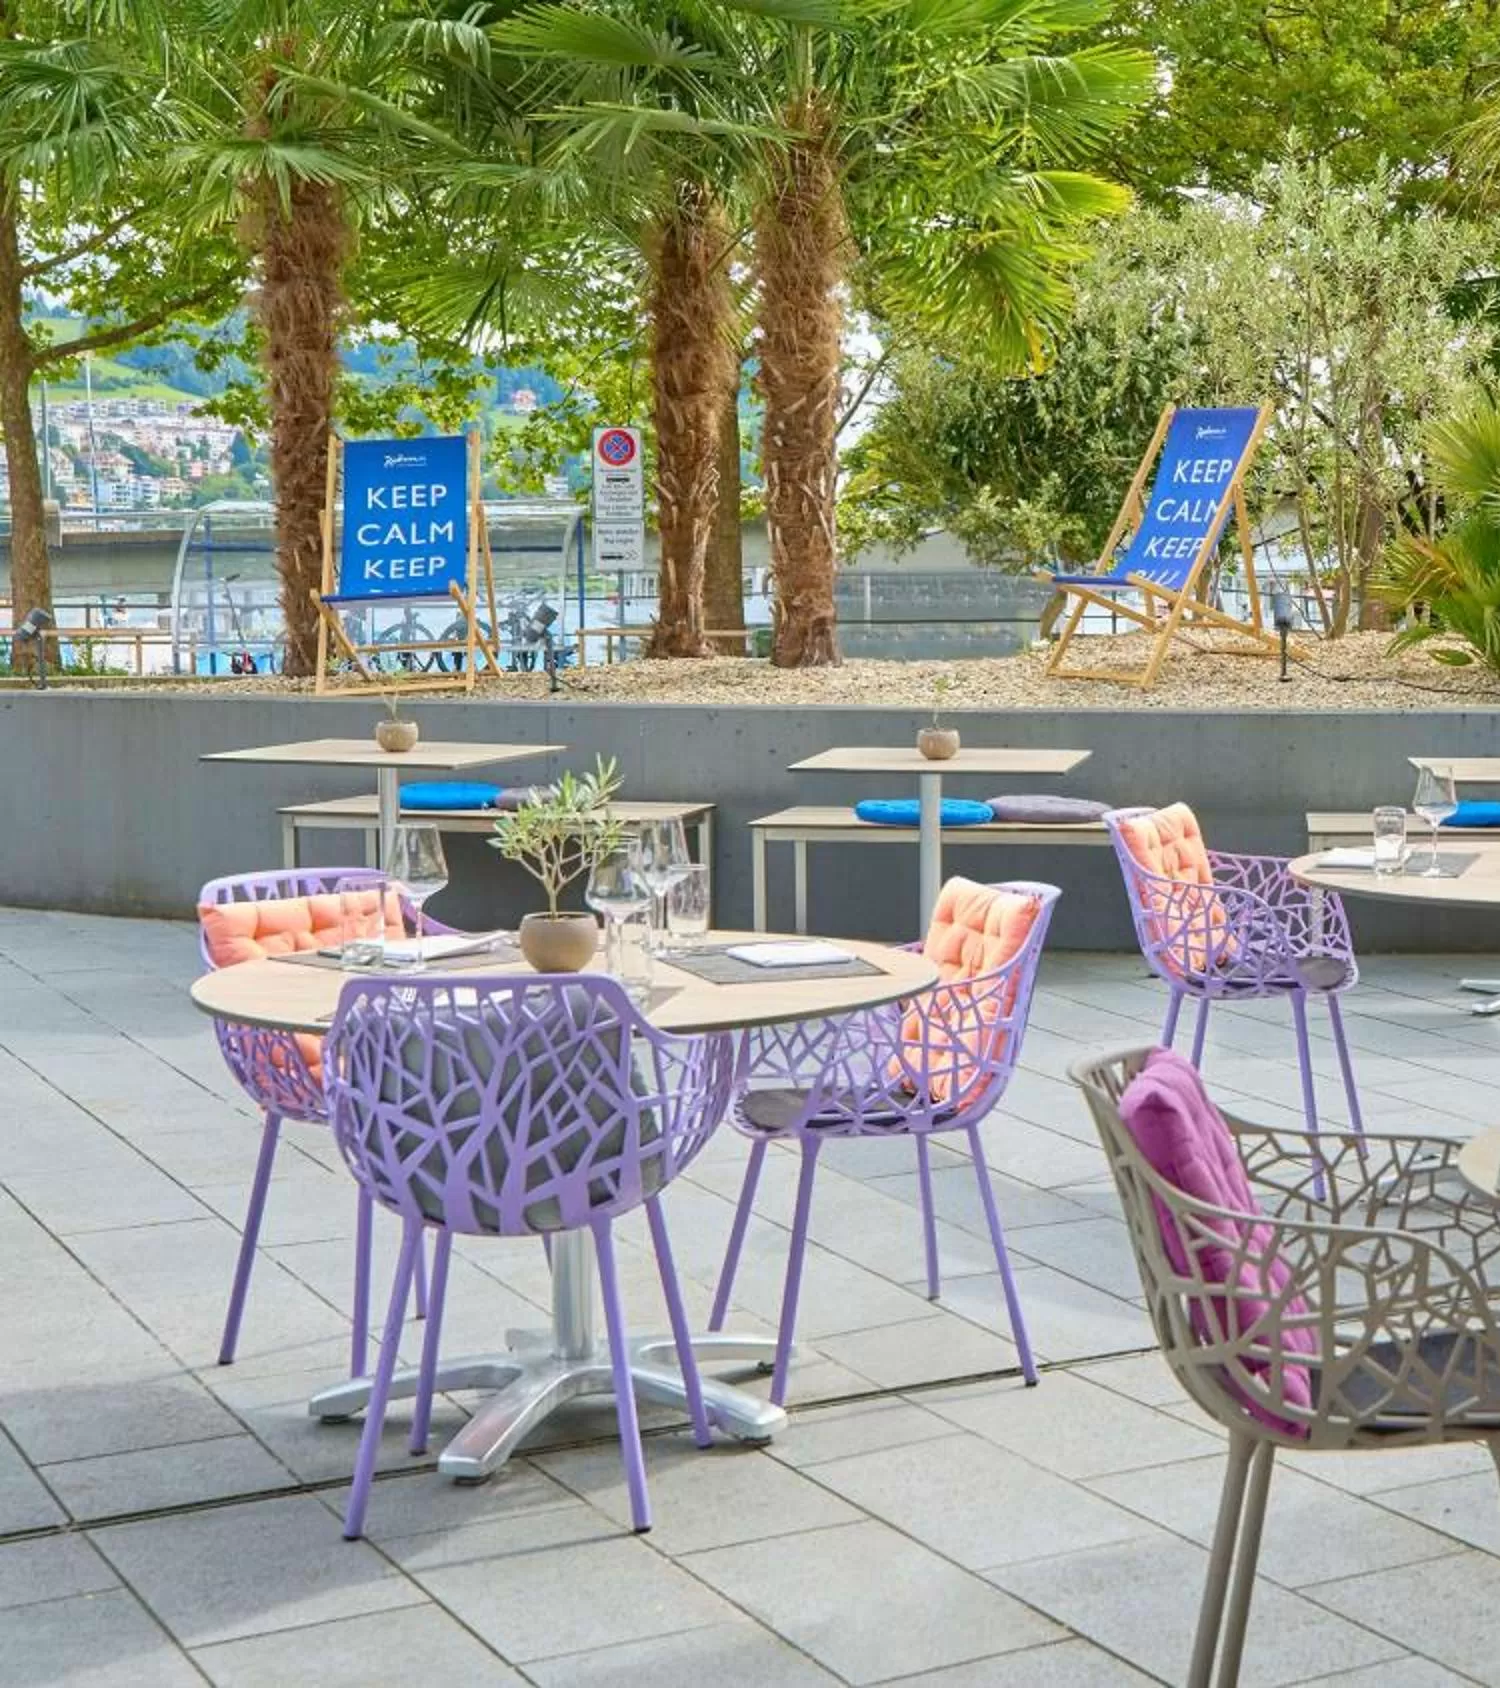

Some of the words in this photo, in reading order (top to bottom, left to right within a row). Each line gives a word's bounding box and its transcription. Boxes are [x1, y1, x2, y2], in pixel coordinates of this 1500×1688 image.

[1173, 459, 1233, 483] KEEP
[367, 484, 447, 509] KEEP
[357, 520, 454, 546] CALM
[363, 556, 447, 580] KEEP
